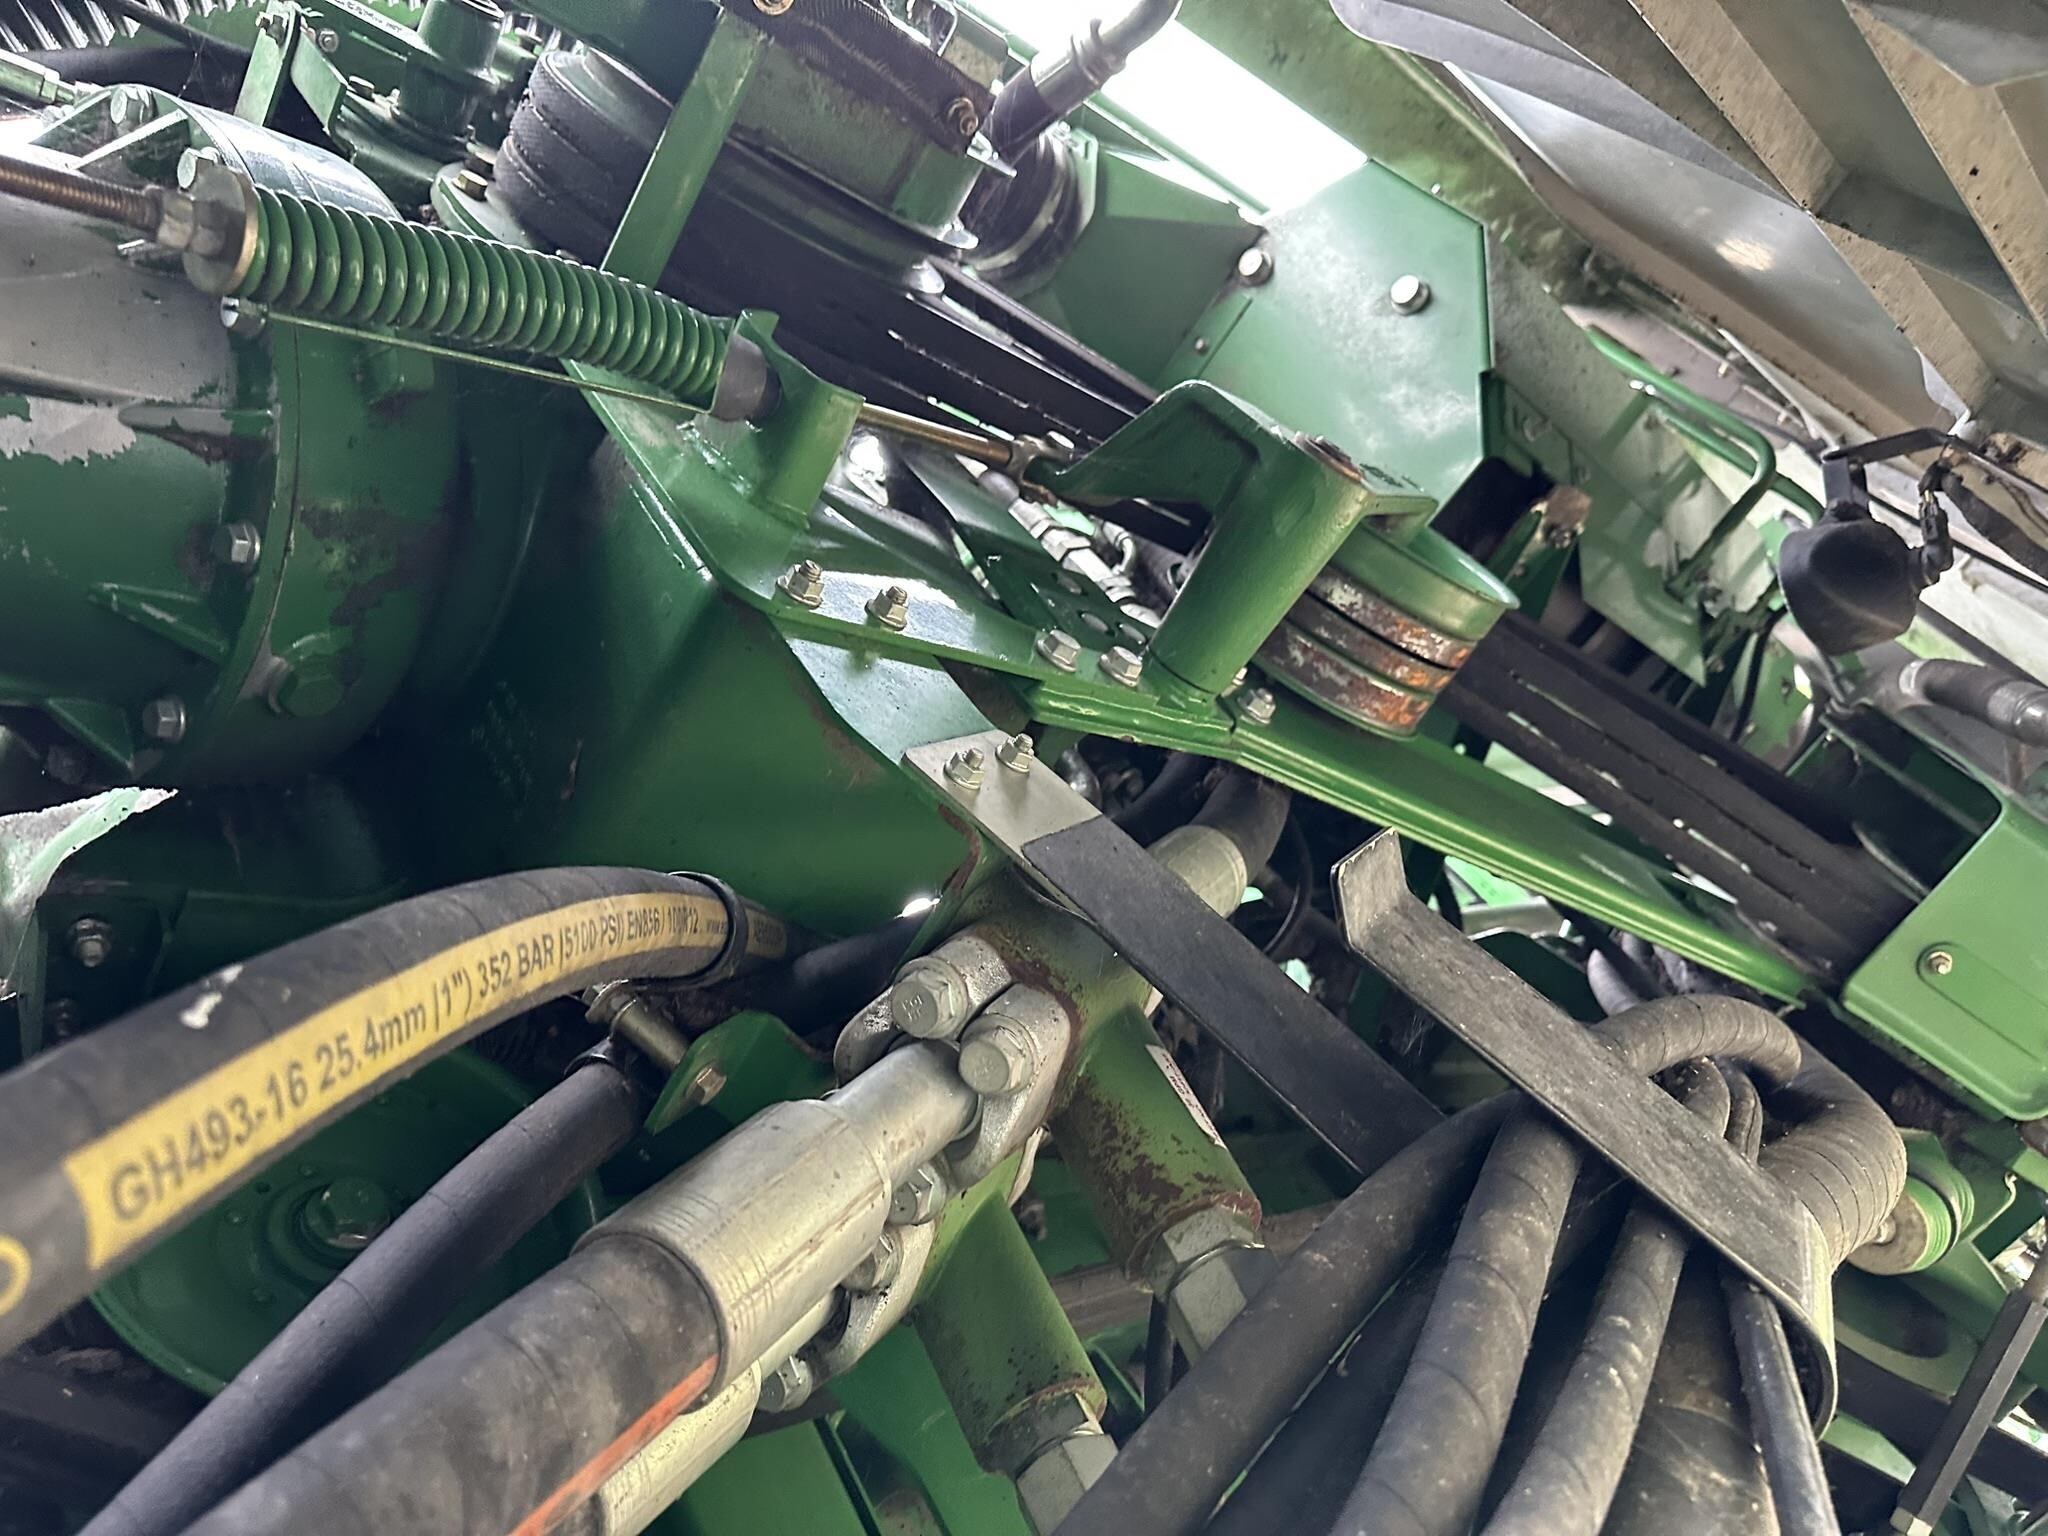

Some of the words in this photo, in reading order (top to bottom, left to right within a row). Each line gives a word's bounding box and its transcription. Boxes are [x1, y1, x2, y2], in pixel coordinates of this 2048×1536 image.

[112, 1061, 308, 1221] GH493-16
[477, 949, 512, 999] 352
[517, 932, 554, 977] BAR
[602, 914, 624, 950] PSI)
[627, 906, 659, 940] EN856
[667, 906, 699, 934] 100R12
